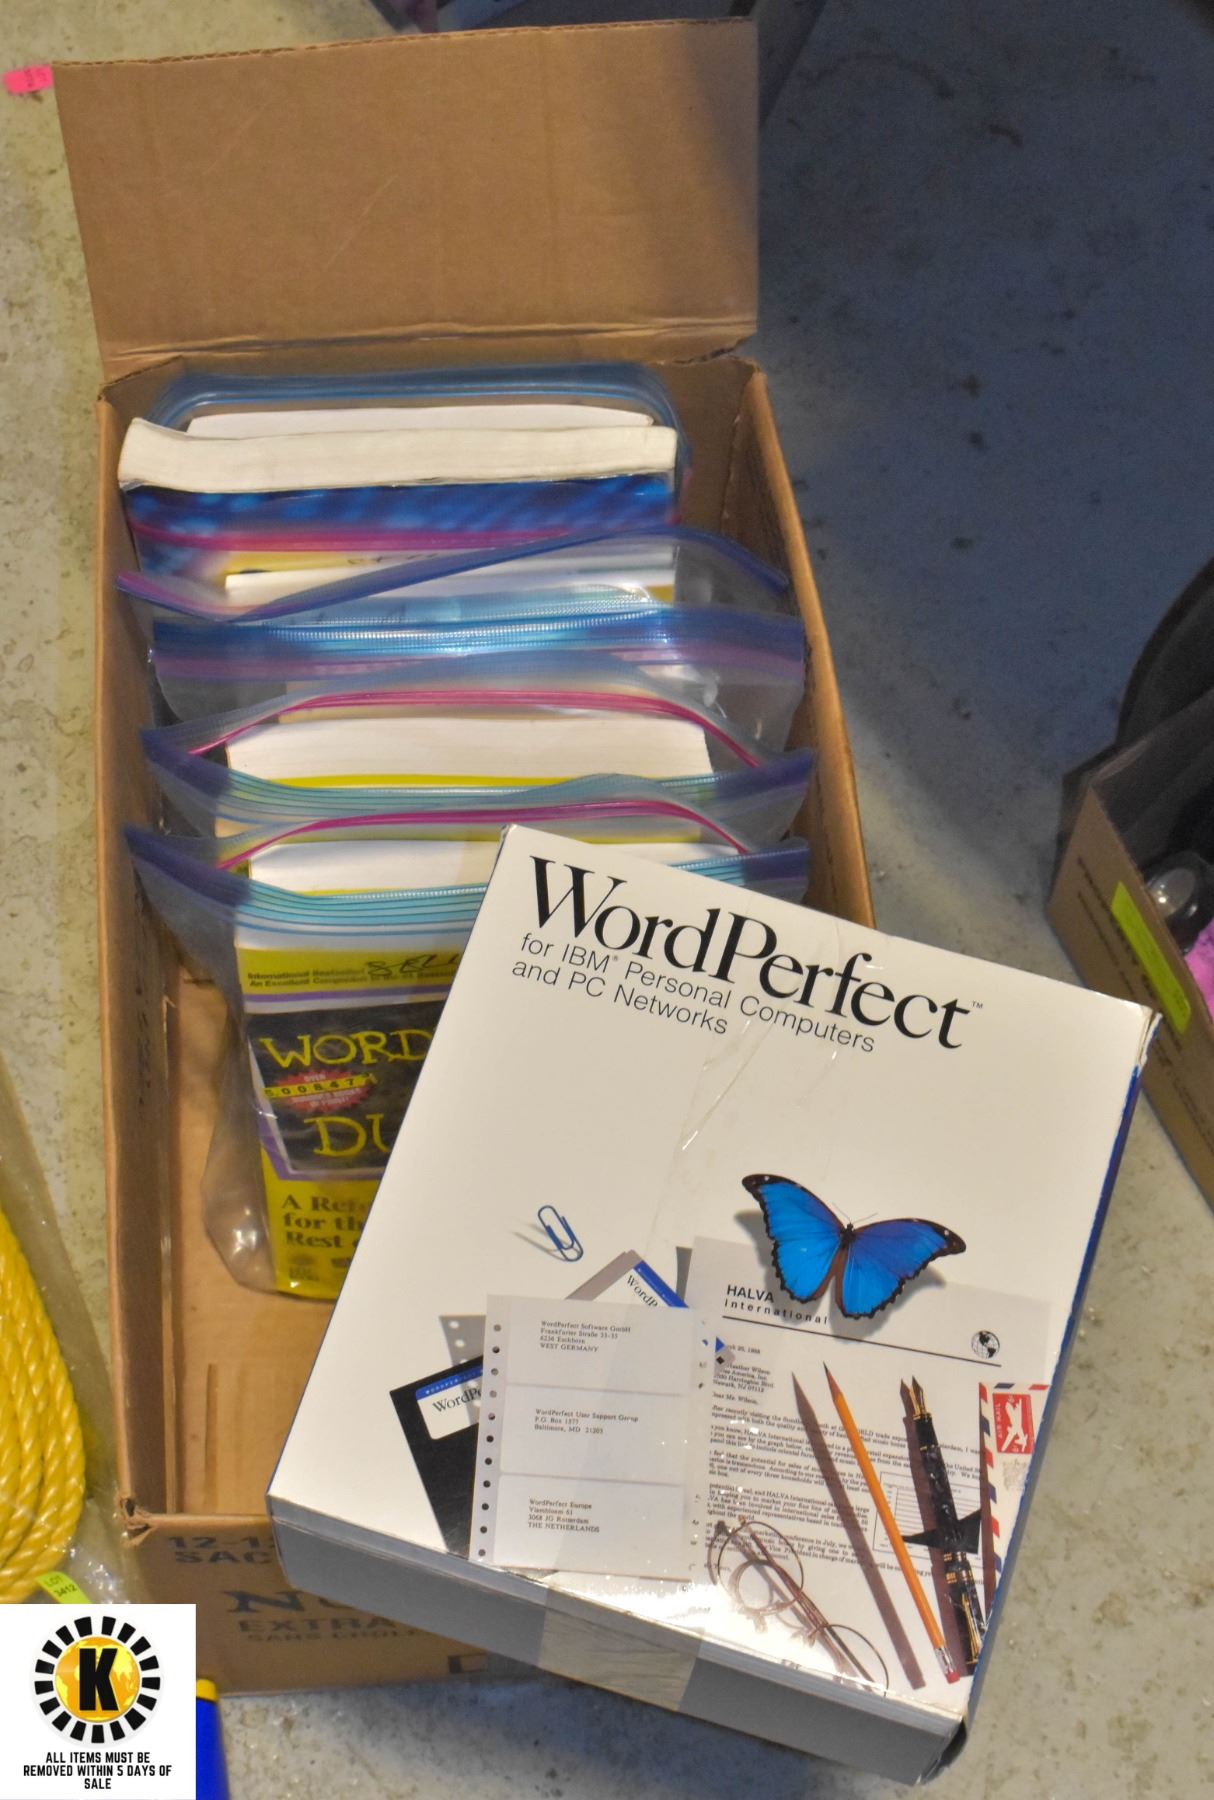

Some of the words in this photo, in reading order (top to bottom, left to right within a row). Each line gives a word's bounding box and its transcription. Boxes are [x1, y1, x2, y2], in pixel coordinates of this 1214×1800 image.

[529, 855, 970, 1050] WordPerfect
[512, 959, 559, 987] and
[568, 971, 606, 998] PC
[613, 984, 729, 1035] Networks
[521, 932, 554, 957] for
[624, 961, 731, 1010] Personal
[740, 995, 876, 1053] Computers
[281, 1194, 302, 1210] A
[284, 1212, 326, 1230] for
[286, 1231, 343, 1249] Rest
[726, 1284, 775, 1304] HALVA
[540, 1342, 559, 1350] WEST
[560, 1344, 599, 1353] GERMANY
[545, 1523, 600, 1533] NETHERLANDS
